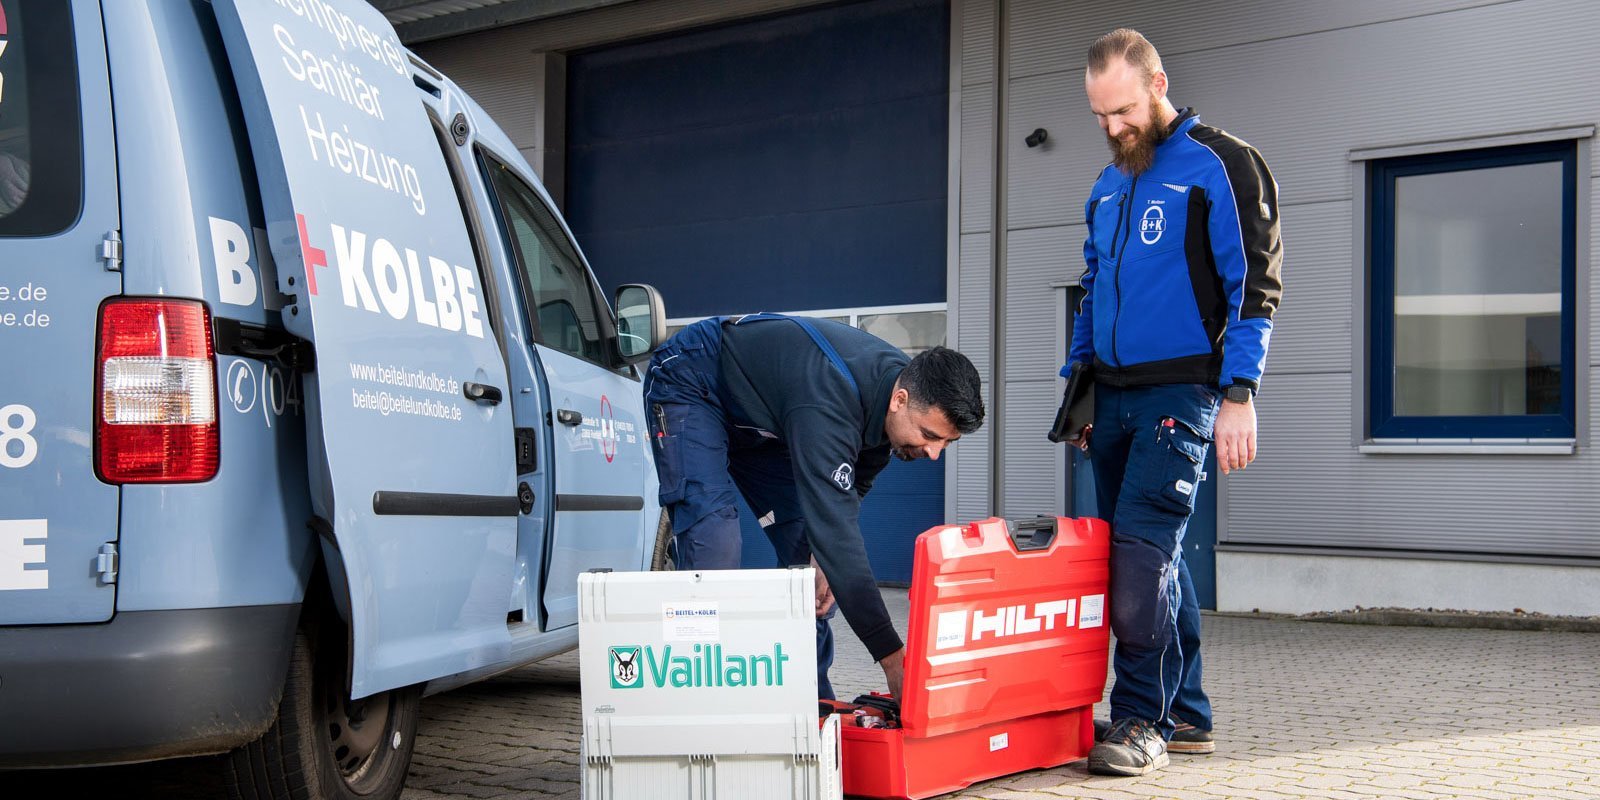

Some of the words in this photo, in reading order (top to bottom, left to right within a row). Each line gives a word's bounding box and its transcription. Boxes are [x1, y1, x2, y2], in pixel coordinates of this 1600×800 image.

[273, 23, 384, 121] Sanitär
[299, 104, 426, 215] Heizung
[1141, 219, 1163, 231] B+K
[0, 309, 50, 327] e.de
[350, 362, 459, 395] www.beitelundkolbe.de
[352, 388, 462, 421] beitel@beitelundkolbe.de
[971, 598, 1077, 641] HILTI
[643, 642, 789, 688] Vaillant
